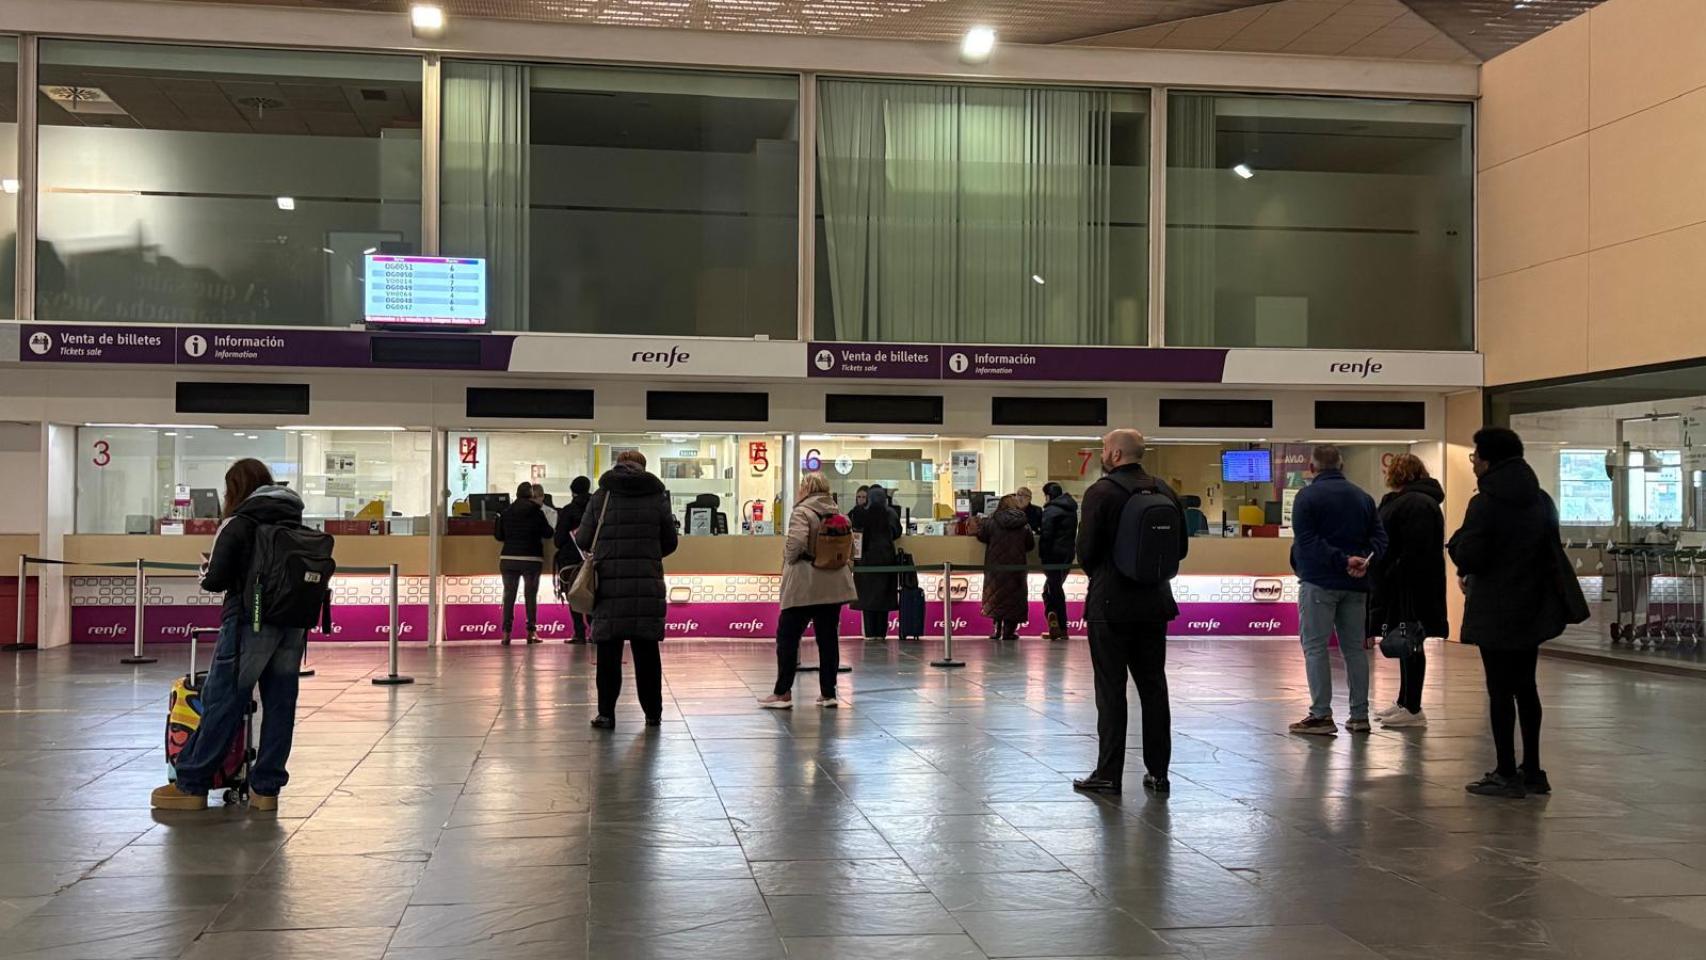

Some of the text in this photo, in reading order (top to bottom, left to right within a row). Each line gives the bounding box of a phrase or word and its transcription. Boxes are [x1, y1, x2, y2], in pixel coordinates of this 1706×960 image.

[60, 333, 161, 346] Venta de billetes
[214, 335, 285, 348] Información
[60, 347, 102, 356] Tickets sale
[214, 350, 258, 359] Information
[631, 345, 690, 369] renfe
[841, 350, 929, 363] Venta de billetes
[974, 353, 1036, 365] Información
[841, 364, 863, 372] Tickets
[975, 367, 1012, 375] Information
[1330, 357, 1383, 379] renfe
[93, 440, 110, 467] 3
[462, 442, 479, 469] 4
[753, 448, 769, 472] 5
[806, 448, 821, 472] 6
[1284, 454, 1304, 464] AVLO
[1077, 452, 1092, 476] 7
[1253, 584, 1282, 596] renfe
[87, 623, 127, 637] renfe
[375, 621, 413, 636] refe
[460, 620, 497, 635] renfe
[535, 620, 566, 635] enfe
[664, 619, 699, 633] renfe
[729, 618, 764, 633] renfe
[1187, 618, 1221, 632] renfe
[1247, 618, 1281, 632] renfe
